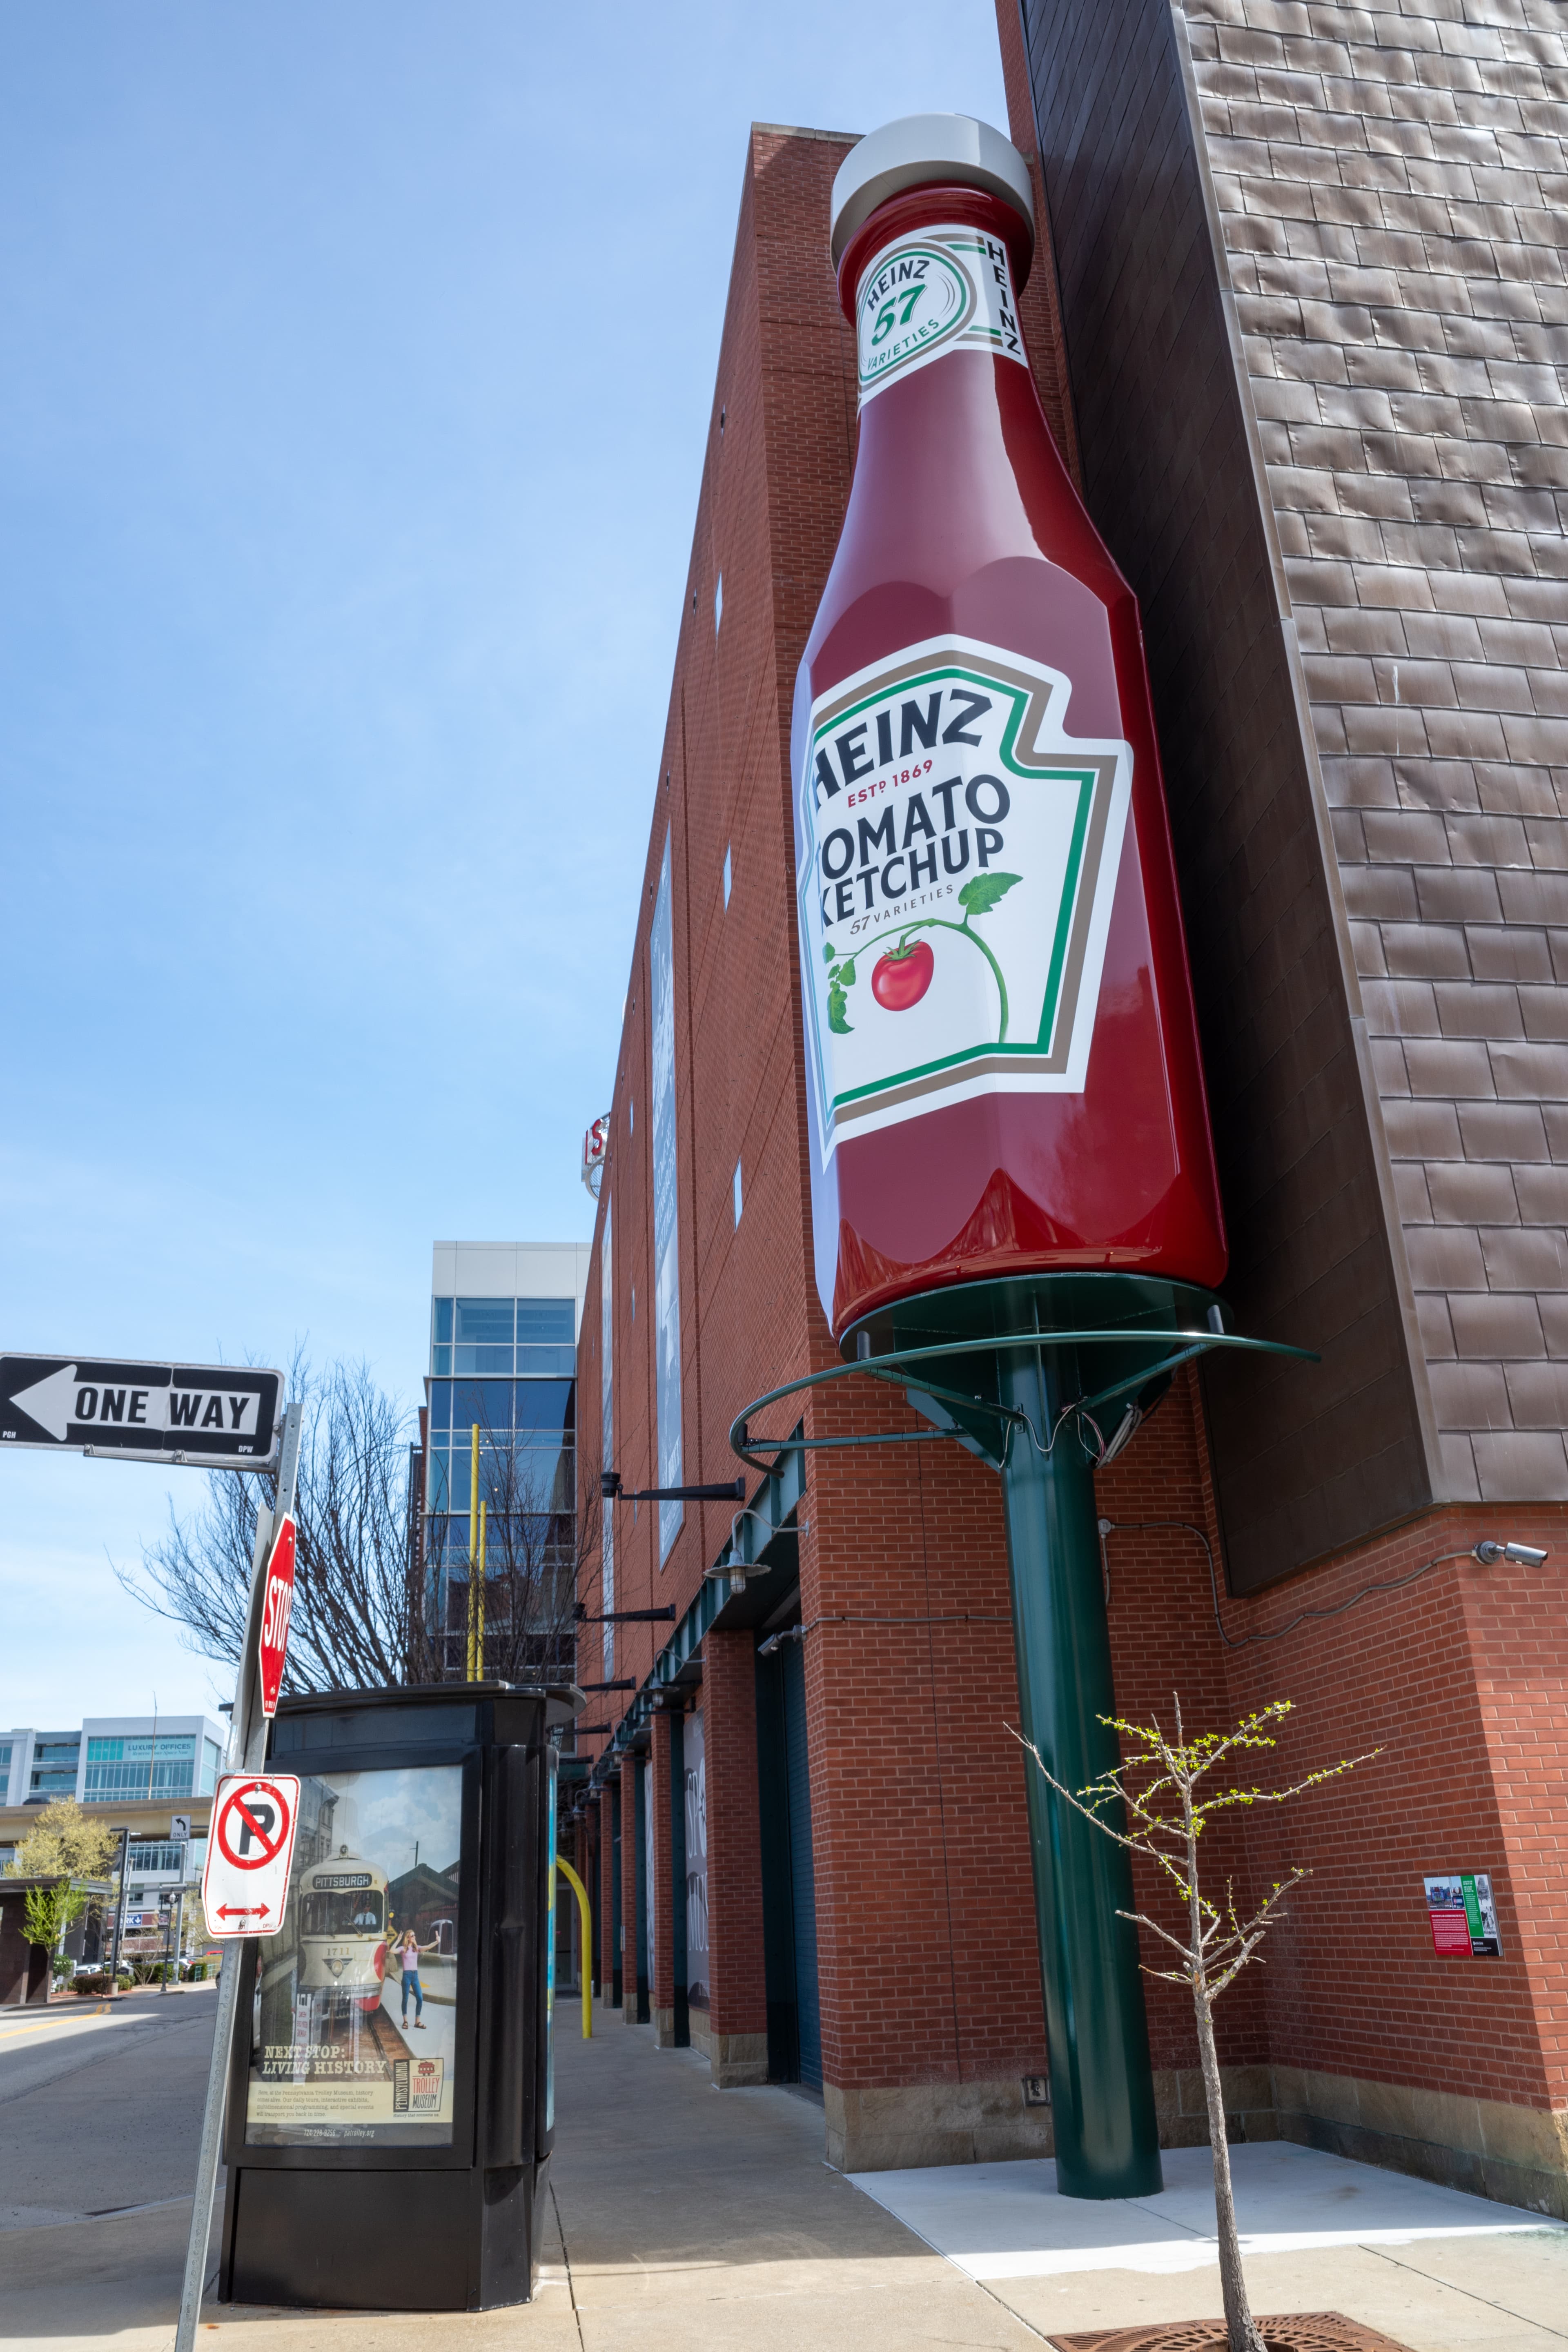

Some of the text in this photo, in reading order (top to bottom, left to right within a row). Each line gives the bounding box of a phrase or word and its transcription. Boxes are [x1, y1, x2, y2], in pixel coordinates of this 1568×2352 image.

[867, 260, 930, 312] HEINZ
[987, 241, 1021, 356] HEINZ
[871, 283, 928, 347] 57
[867, 318, 940, 371] VARIETIES
[892, 759, 933, 787] 1869
[816, 774, 1011, 880] OMATO
[850, 884, 953, 935] 57 VARIETIES
[75, 1387, 250, 1429] ONE WAY
[2, 1430, 16, 1439] PGH
[238, 1445, 254, 1453] DPW
[264, 1575, 292, 1652] STOP
[316, 1875, 369, 1887] PITTSBURGH
[327, 1947, 350, 1956] 1711
[264, 2046, 345, 2059] NEXT STOP:
[262, 2060, 387, 2075] LIVING HISTORY
[395, 2062, 408, 2110] PENNSYLVANIA
[412, 2077, 440, 2094] TROLLEY
[412, 2094, 437, 2109] MUSEUM
[344, 2129, 375, 2138] patrolley.org
